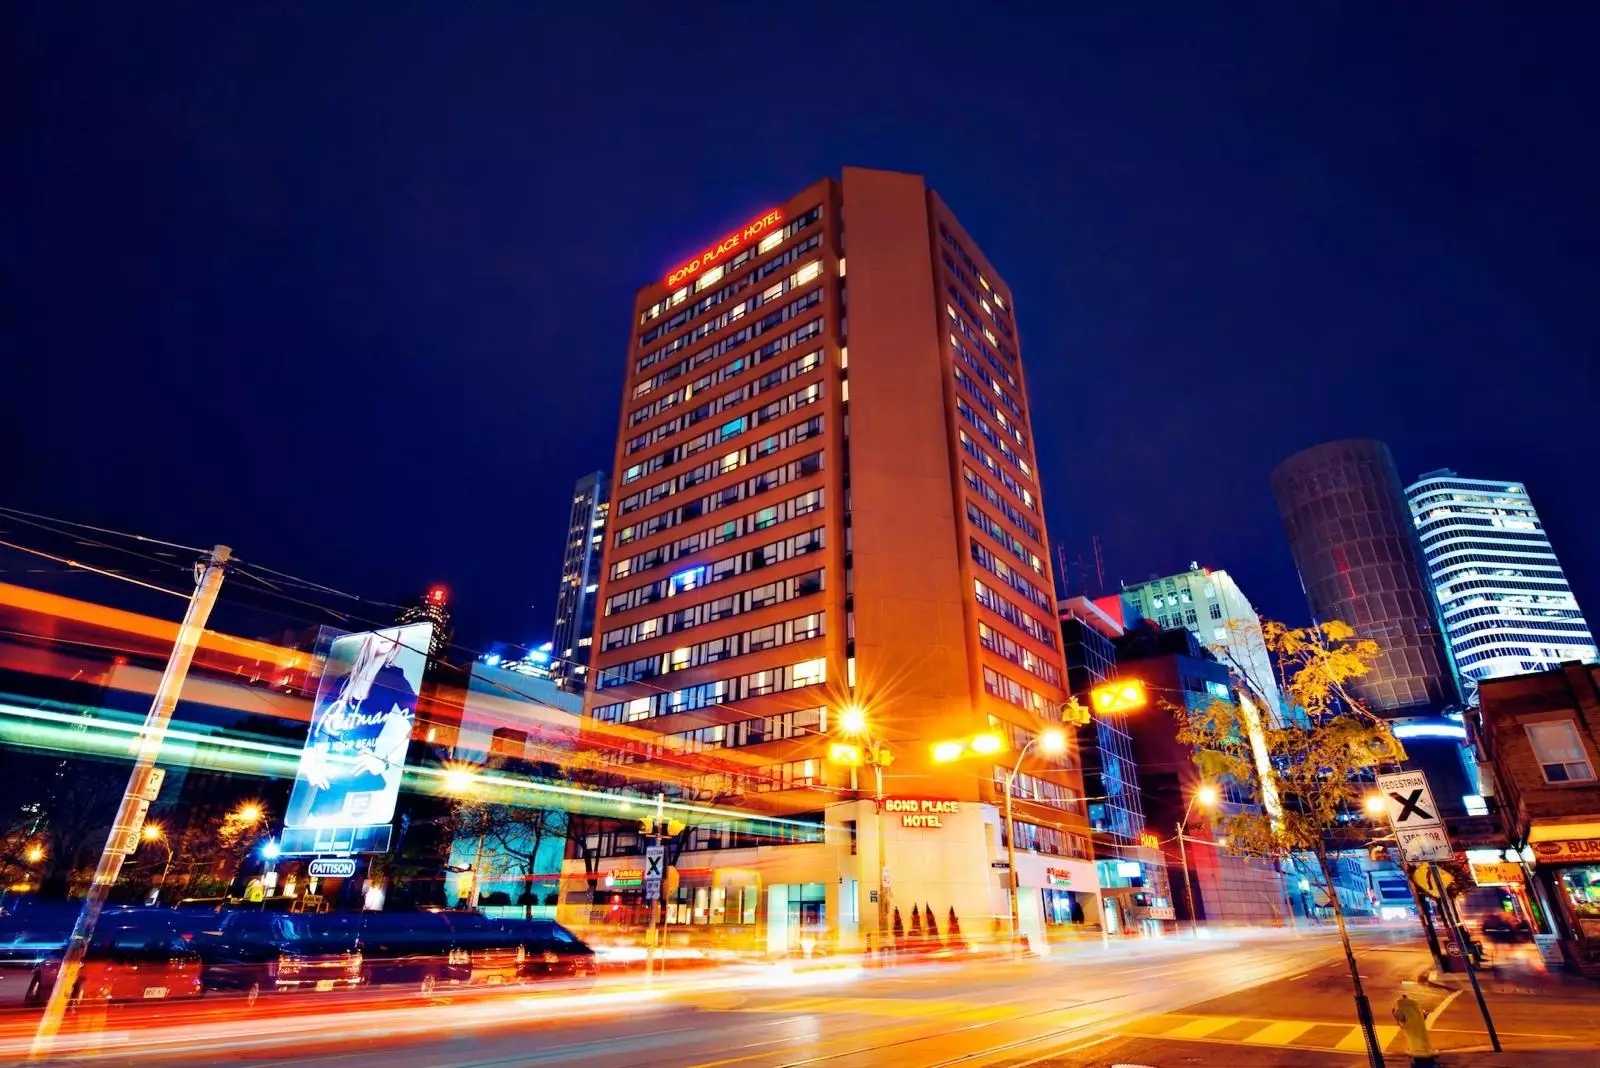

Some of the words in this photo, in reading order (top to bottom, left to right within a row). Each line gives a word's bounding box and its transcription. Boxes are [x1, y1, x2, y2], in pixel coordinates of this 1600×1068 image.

[668, 260, 700, 286] BOND
[703, 234, 740, 264] PLACE
[743, 210, 781, 239] HOTEL
[1381, 777, 1424, 790] PEDESTRIAN
[885, 799, 918, 812] BOND
[921, 800, 958, 813] PLACE
[903, 814, 942, 828] HOTEL
[1567, 840, 1600, 854] BUR
[312, 863, 352, 874] PATTISON
